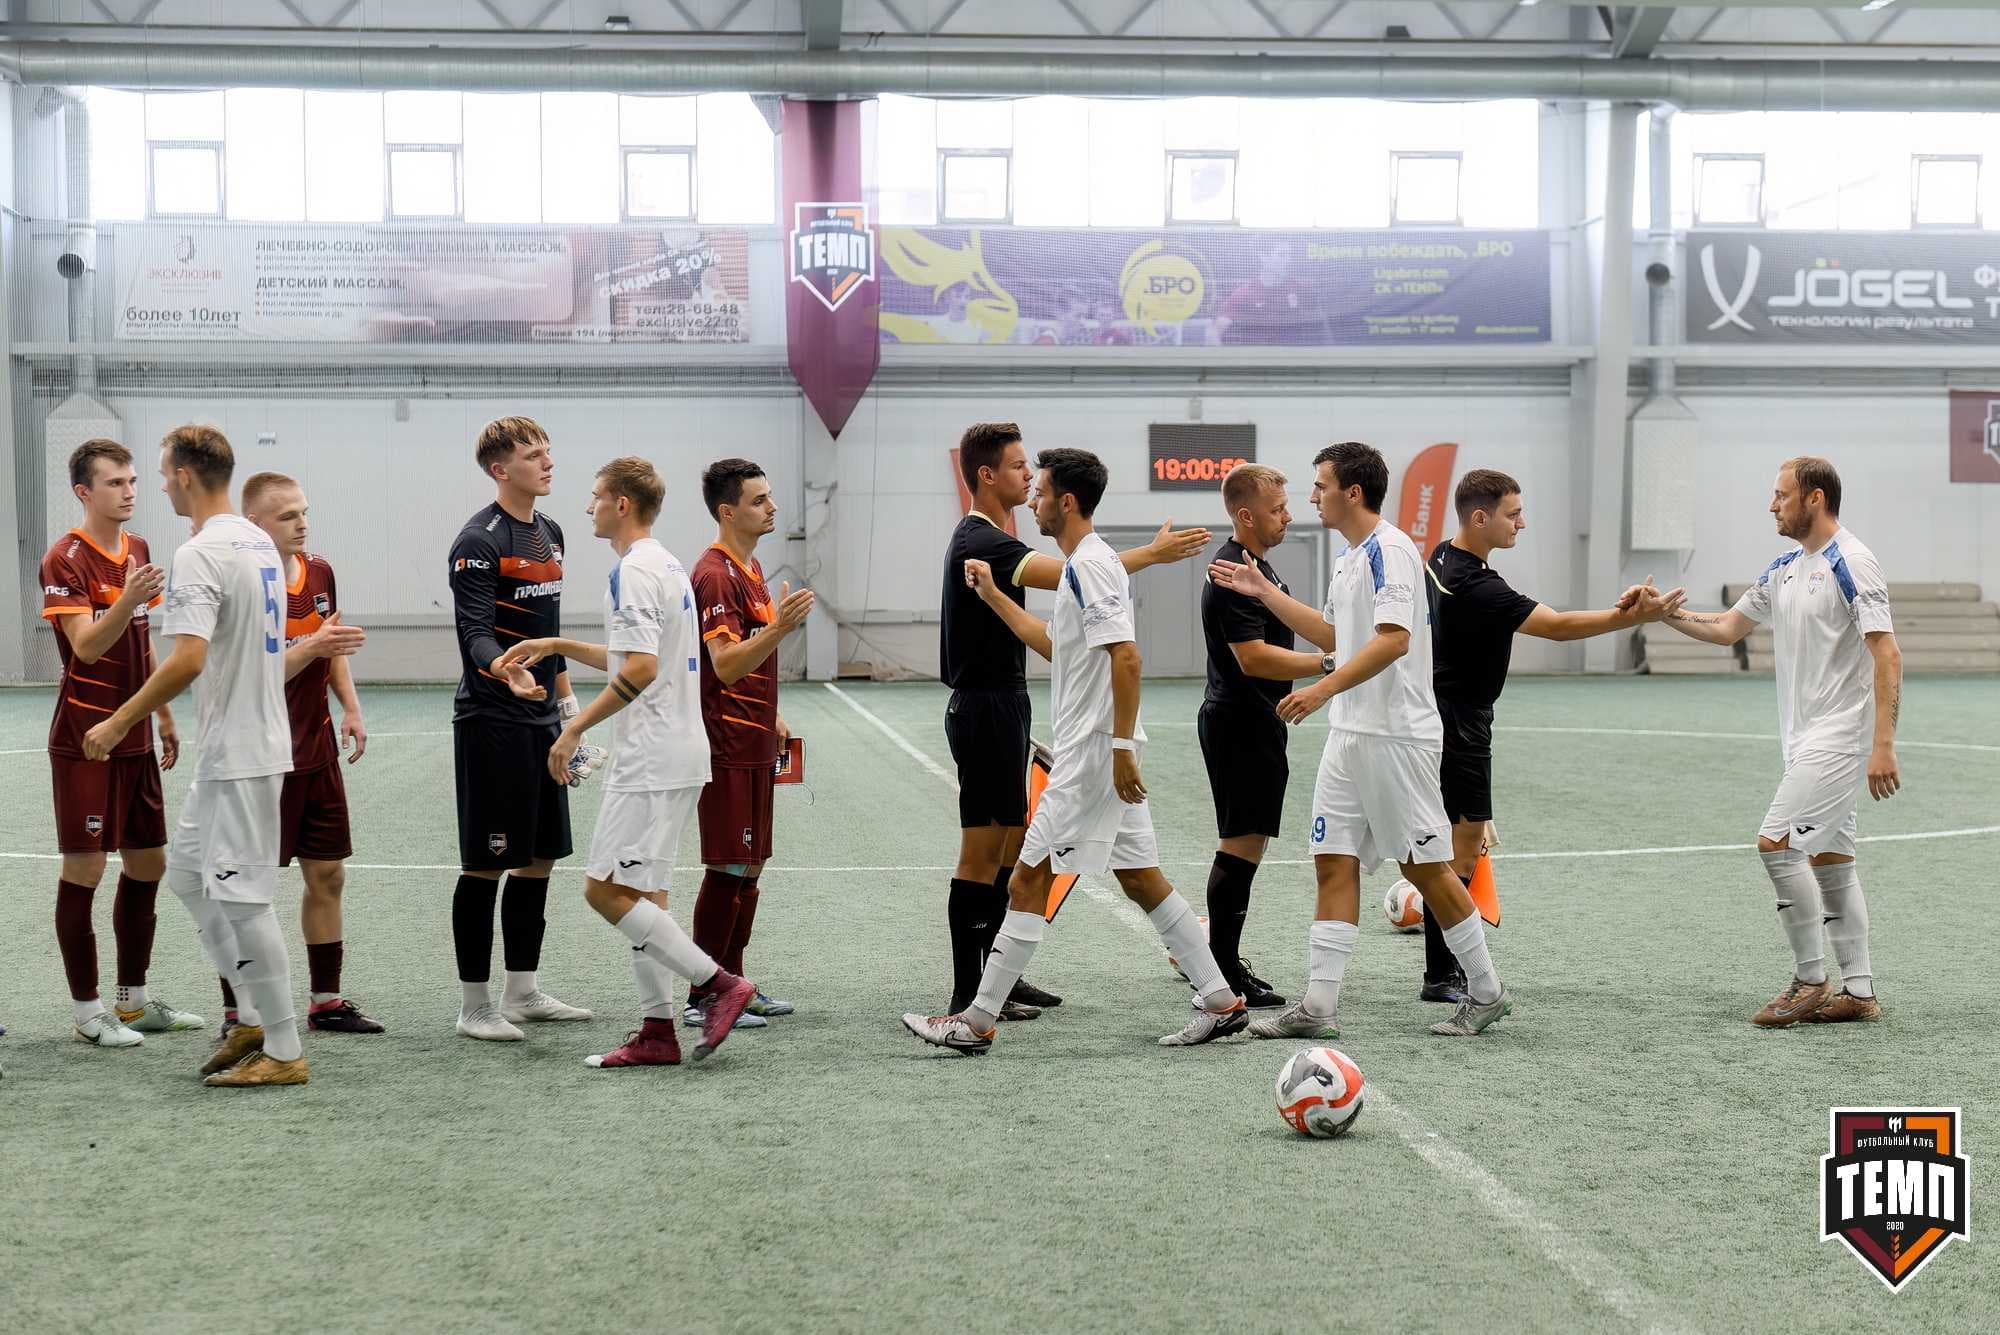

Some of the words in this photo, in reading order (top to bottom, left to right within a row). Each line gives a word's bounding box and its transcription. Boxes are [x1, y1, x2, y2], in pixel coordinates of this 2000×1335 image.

[675, 248, 721, 274] 20%
[799, 232, 866, 270] ТЕМП
[255, 275, 328, 290] ДЕТСКИЙ
[1768, 257, 1974, 308] JÖGEL
[126, 305, 183, 322] более
[1768, 315, 1871, 327] технологии
[1873, 316, 1974, 329] результата
[1154, 458, 1248, 480] 19:00:5
[1411, 483, 1435, 537] Банк
[259, 568, 279, 653] 5
